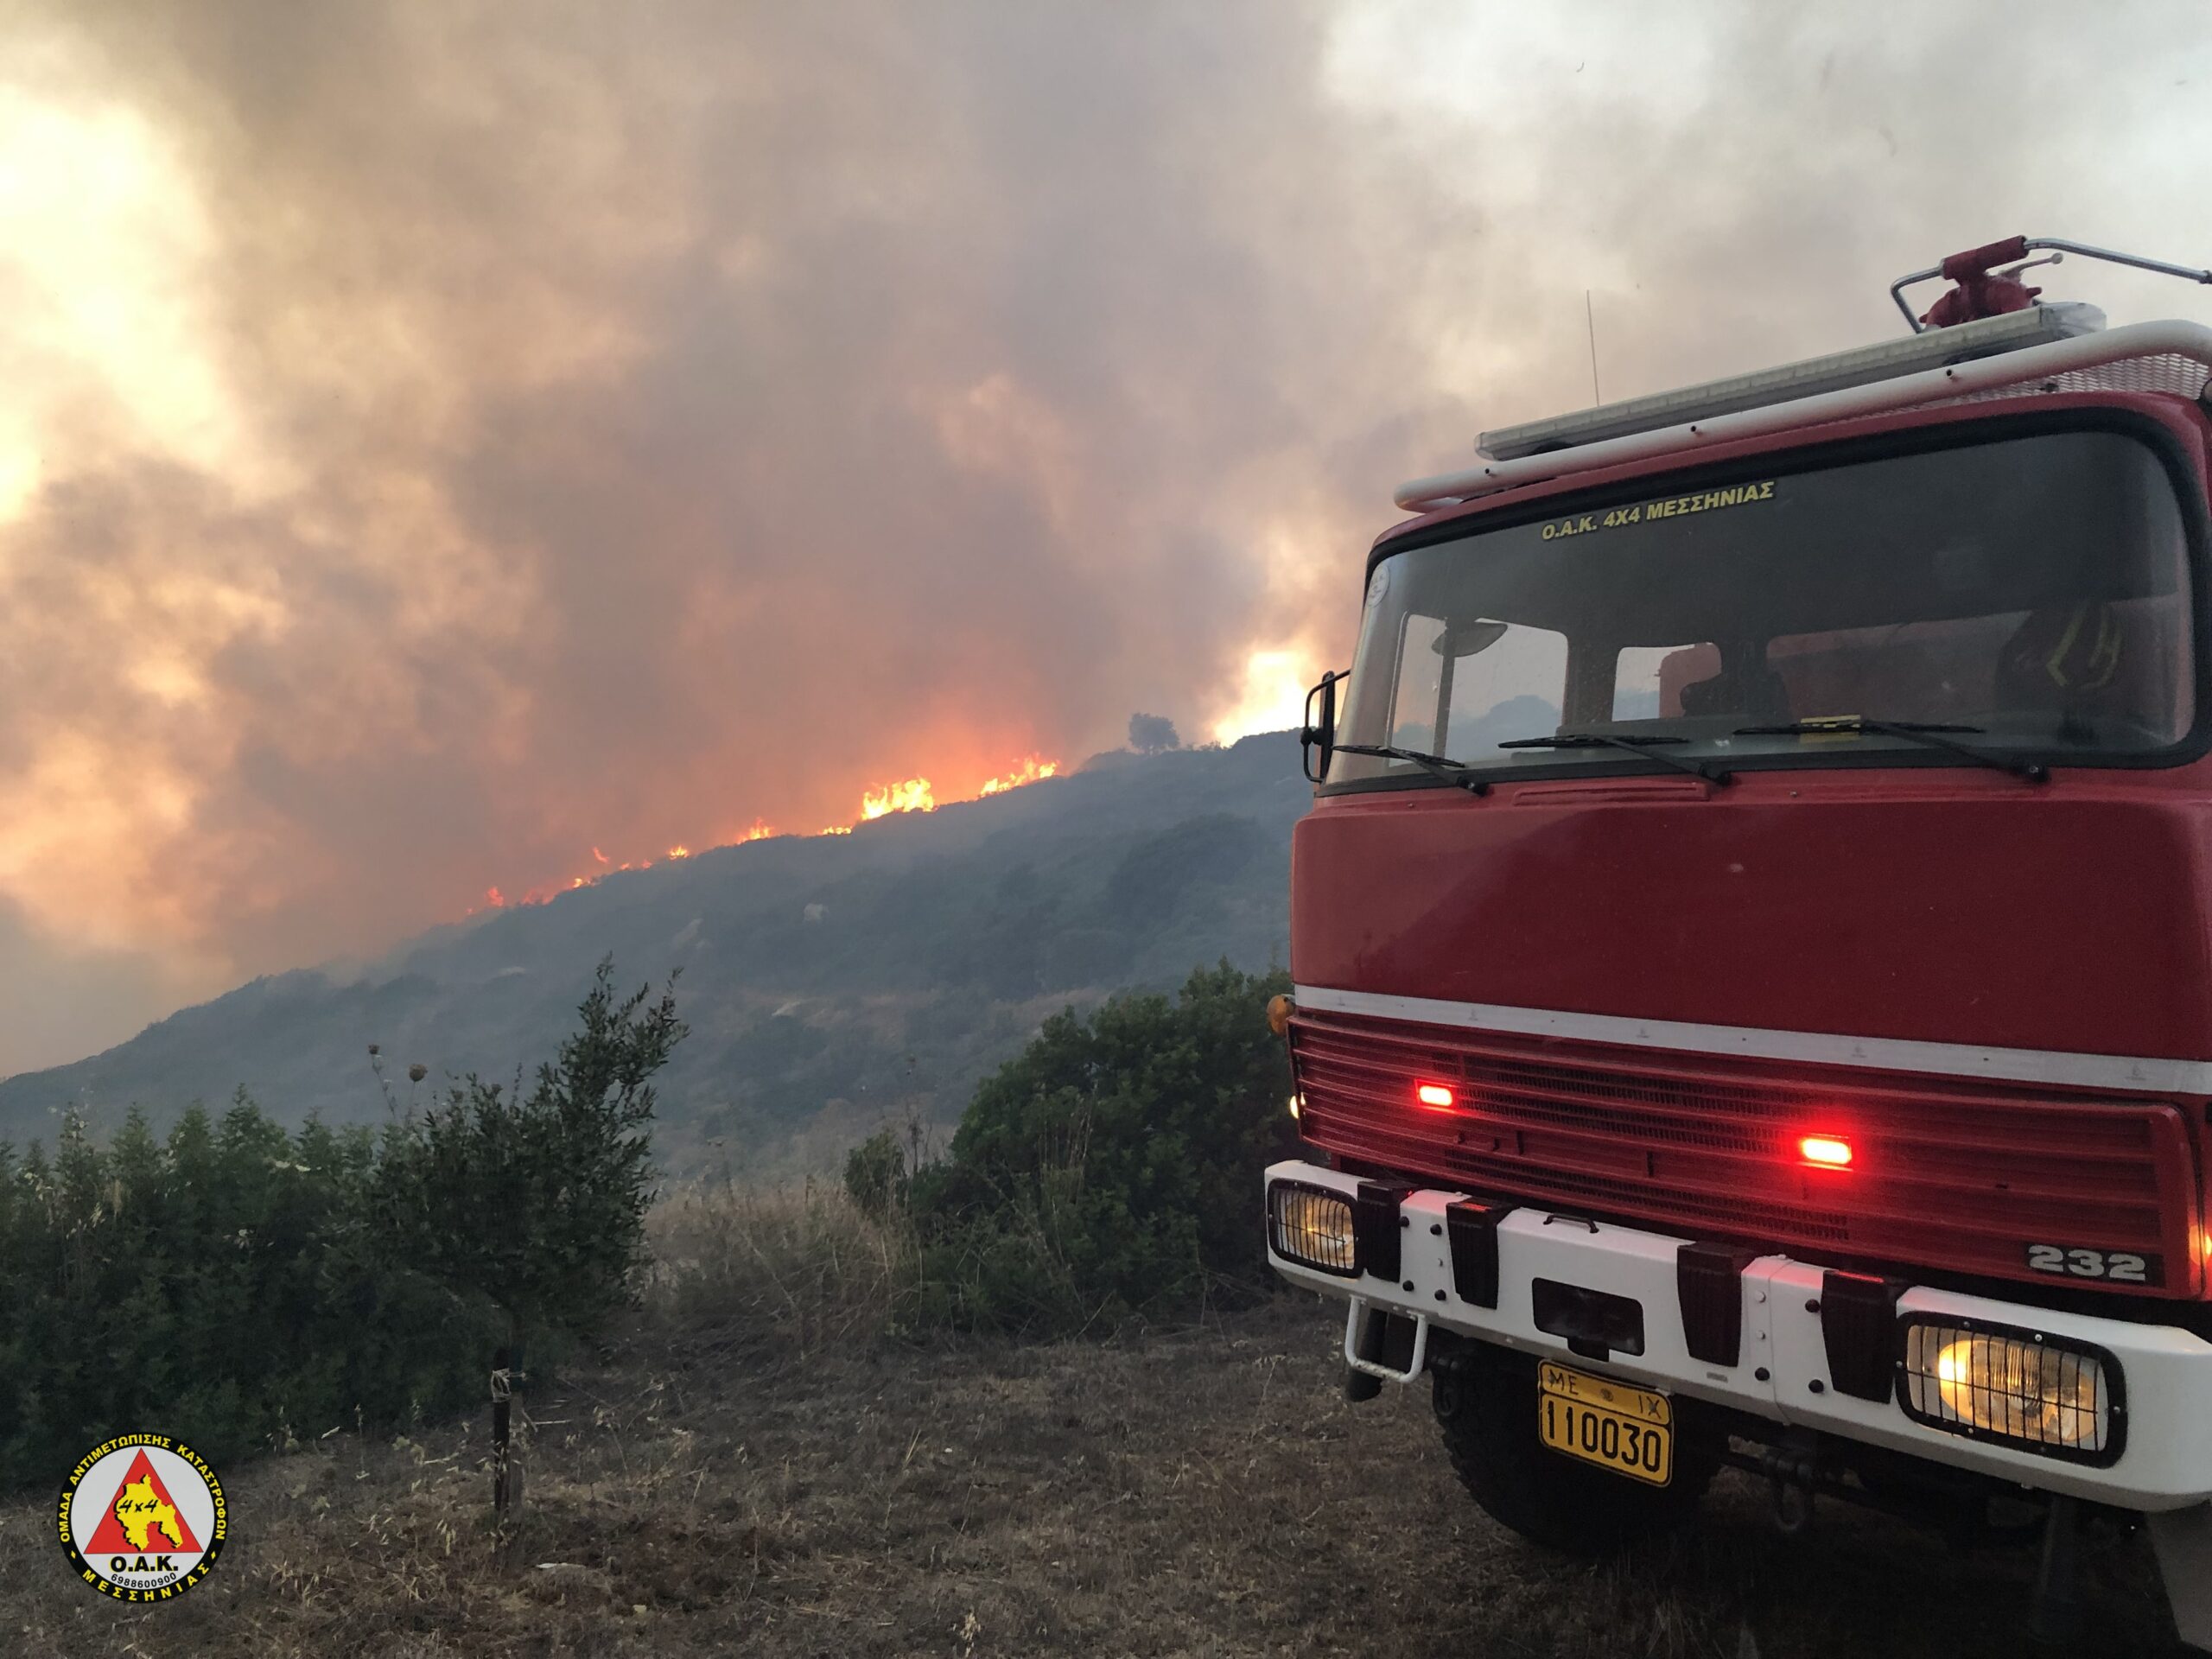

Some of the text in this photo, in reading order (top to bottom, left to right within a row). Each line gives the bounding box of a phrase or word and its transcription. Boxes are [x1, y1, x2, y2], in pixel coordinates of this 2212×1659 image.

[1541, 516, 1597, 540] Ο.Α.Κ.
[1646, 481, 1775, 520] ΜΕΣΣΗΝΙΑΣ
[2028, 1244, 2145, 1281] 232
[1548, 1401, 1662, 1472] 110030
